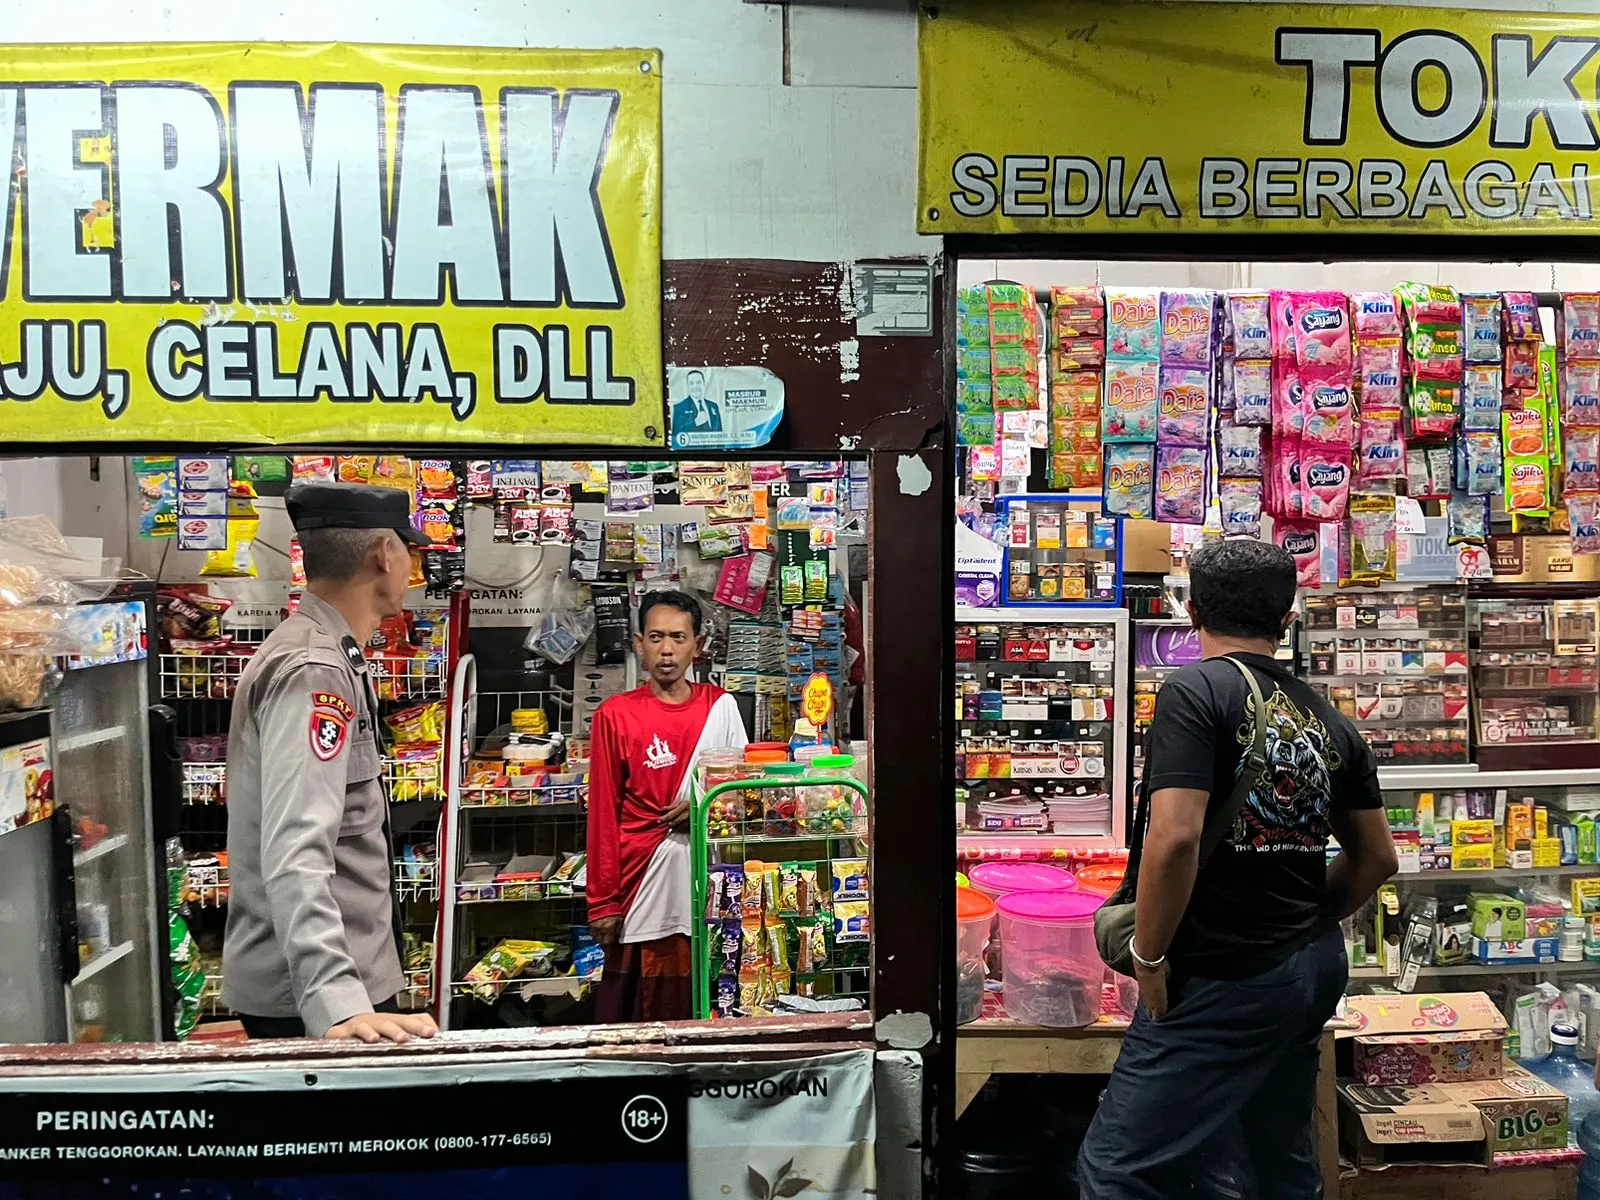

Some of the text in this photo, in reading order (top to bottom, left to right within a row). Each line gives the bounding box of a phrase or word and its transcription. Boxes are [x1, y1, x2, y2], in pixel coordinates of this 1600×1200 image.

[1275, 27, 1600, 149] TOK
[949, 153, 1592, 221] SEDIA BERBAGAI
[1111, 299, 1156, 324] Daia
[1363, 302, 1393, 313] Klin
[1164, 310, 1209, 335] Daia
[1304, 311, 1341, 329] Sayang
[1242, 328, 1266, 339] Klin
[1474, 329, 1497, 340] Klin
[1571, 329, 1598, 340] Klin
[1431, 341, 1456, 353] Rinso
[0, 319, 634, 421] JU, CELANA, DLL
[1369, 374, 1397, 385] Klin
[1108, 380, 1156, 406] Daia
[1315, 391, 1347, 407] Sayang
[1161, 389, 1207, 414] Daia
[1243, 395, 1267, 406] Klin
[1473, 396, 1497, 408] Klin
[1572, 395, 1598, 407] Klin
[1508, 411, 1541, 425] Sajiku
[680, 433, 687, 444] 6
[1228, 447, 1255, 458] Klin
[1368, 447, 1399, 459] Klin
[422, 460, 450, 469] naak
[1570, 460, 1597, 472] Klin
[1108, 464, 1151, 489] Daia
[1159, 467, 1203, 491] Daia
[1310, 469, 1343, 485] Sayang
[1511, 466, 1544, 481] Sajiku
[494, 477, 537, 486] PANTENE
[681, 476, 727, 486] PANTENE
[467, 484, 491, 494] ABC
[498, 488, 521, 499] ABC
[612, 483, 650, 493] PANTENE
[543, 507, 571, 518] ABC
[1228, 512, 1255, 523] Klin
[237, 609, 275, 617] KARENA
[808, 687, 828, 701] Chupa
[319, 694, 352, 715] SPKT
[1272, 844, 1281, 852] OF
[1498, 940, 1523, 951] ABC
[36, 1109, 215, 1131] PERINGATAN:
[627, 1108, 662, 1129] 18+
[1498, 1109, 1542, 1140] BIG
[56, 1145, 182, 1159] TENGGOROKAN.
[187, 1143, 258, 1158] LAYANAN
[263, 1141, 343, 1157] BERHENTI
[348, 1137, 430, 1153] MEROKOK
[434, 1131, 552, 1151] (0800-177-6565)
